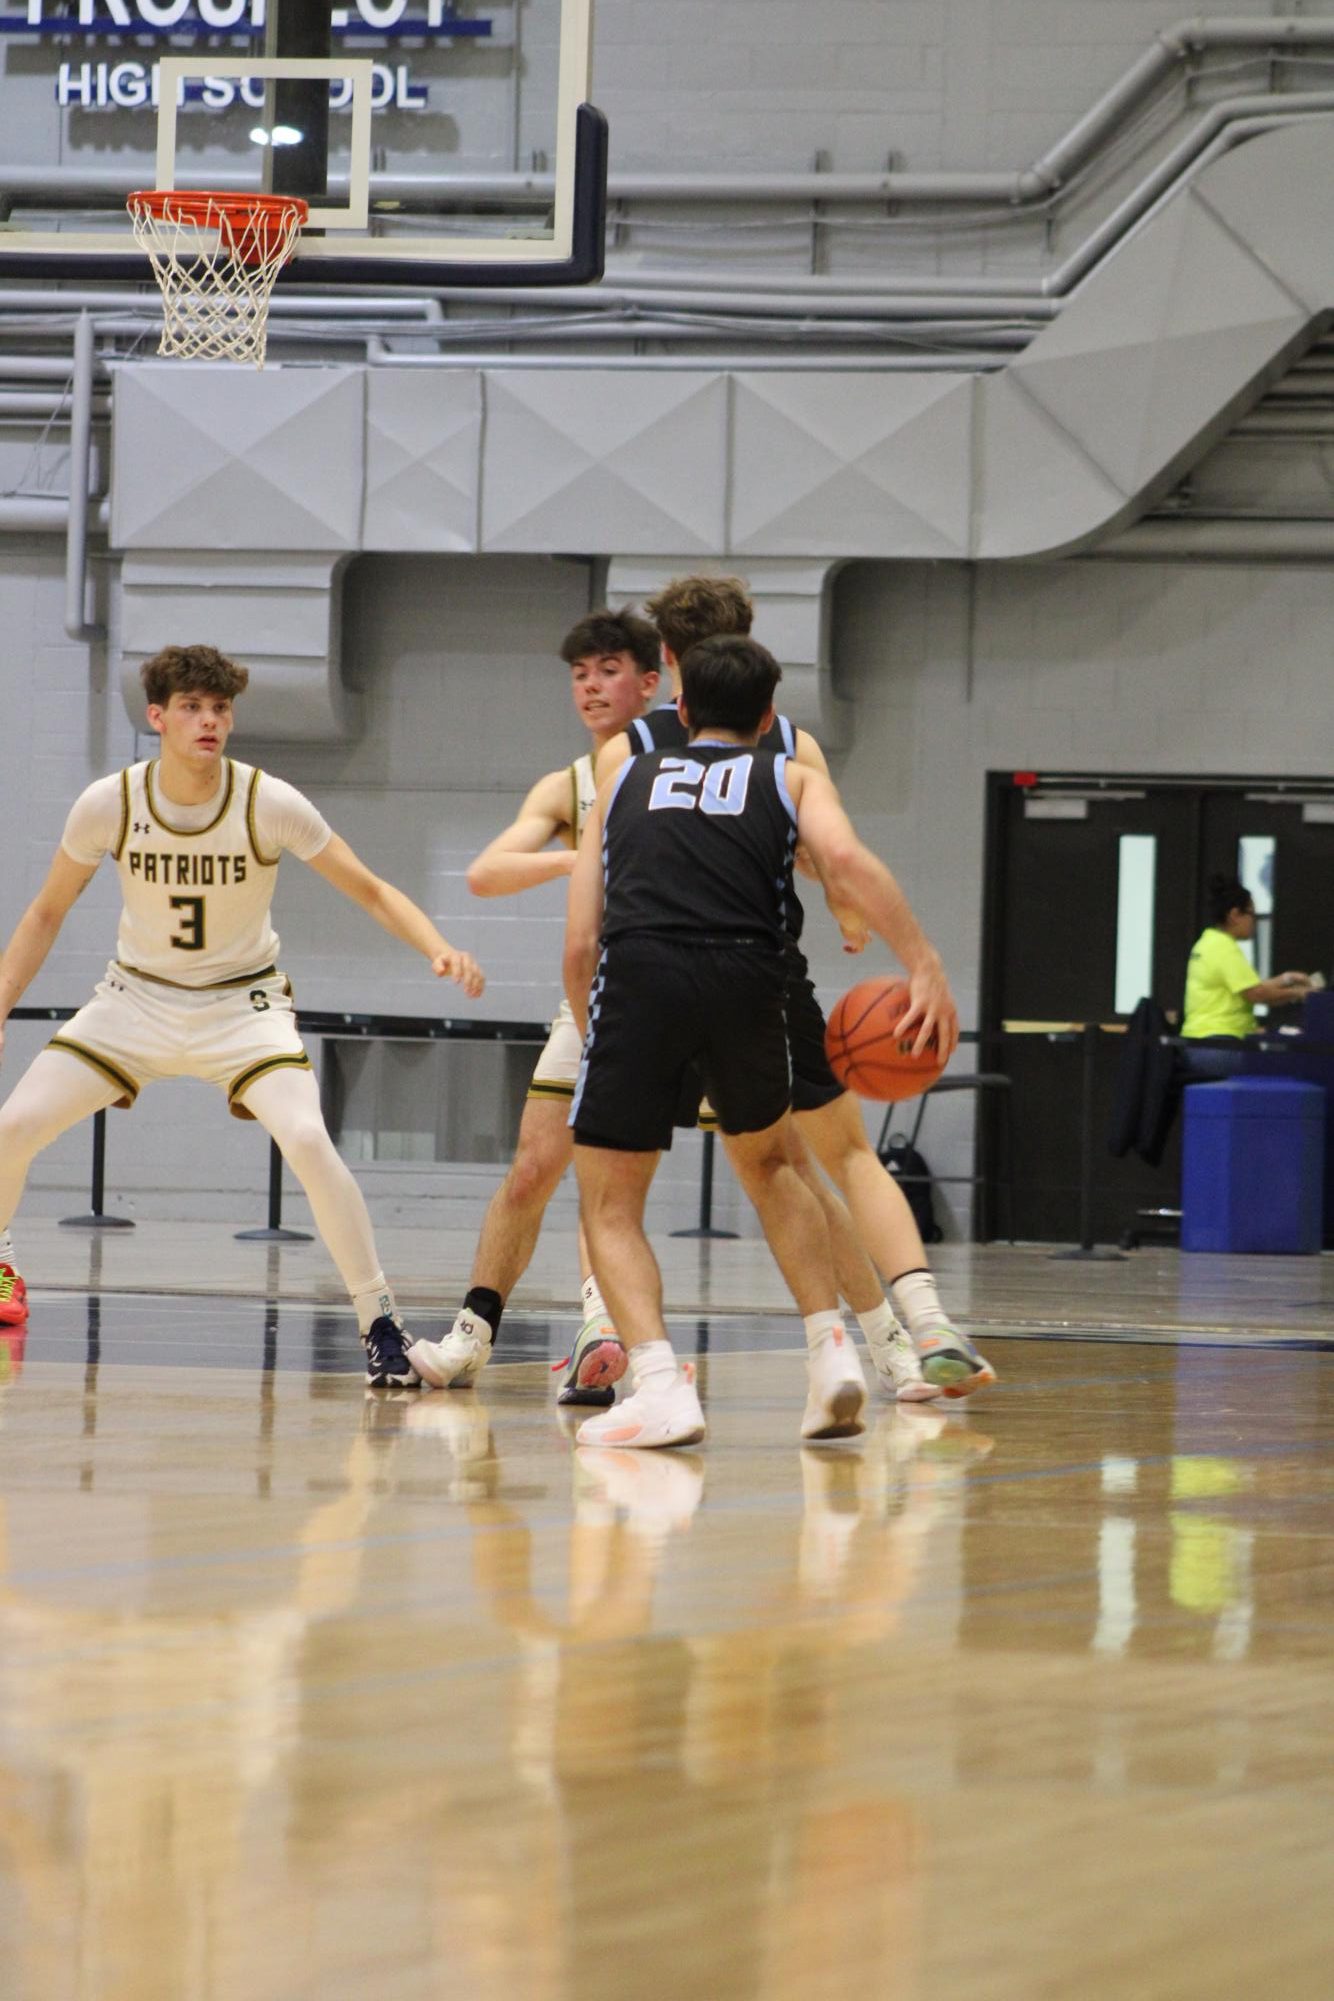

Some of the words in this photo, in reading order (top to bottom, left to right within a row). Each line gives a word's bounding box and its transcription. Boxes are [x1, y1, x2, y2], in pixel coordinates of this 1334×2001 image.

[648, 754, 753, 816] 20
[128, 851, 247, 886] PATRIOTS
[168, 894, 206, 950] 3
